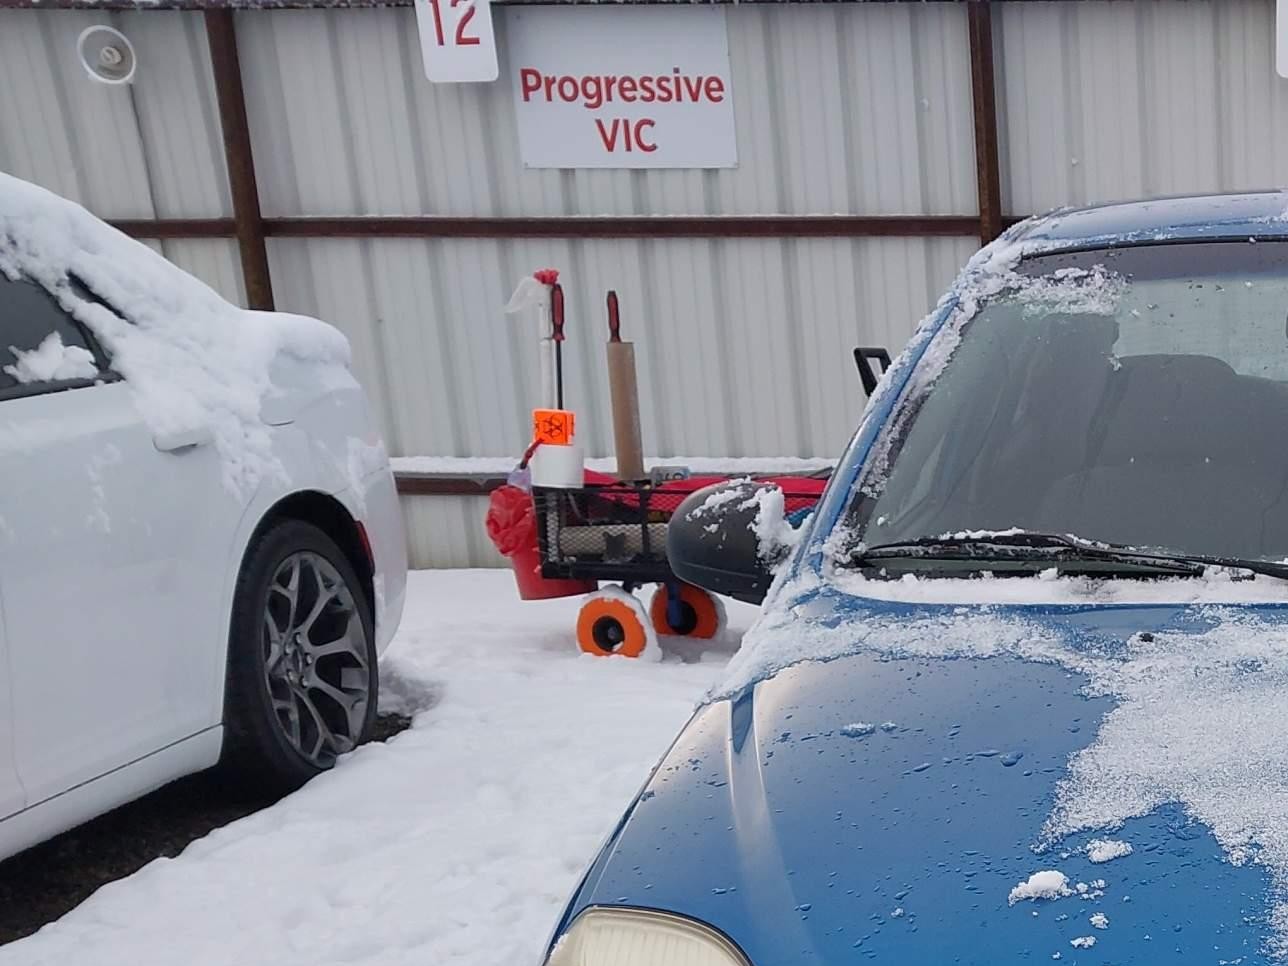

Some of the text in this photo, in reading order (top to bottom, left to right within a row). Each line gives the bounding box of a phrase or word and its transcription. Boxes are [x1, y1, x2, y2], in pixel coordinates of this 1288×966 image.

[429, 0, 481, 45] 12
[520, 67, 725, 109] Progressive
[595, 118, 658, 153] VIC
